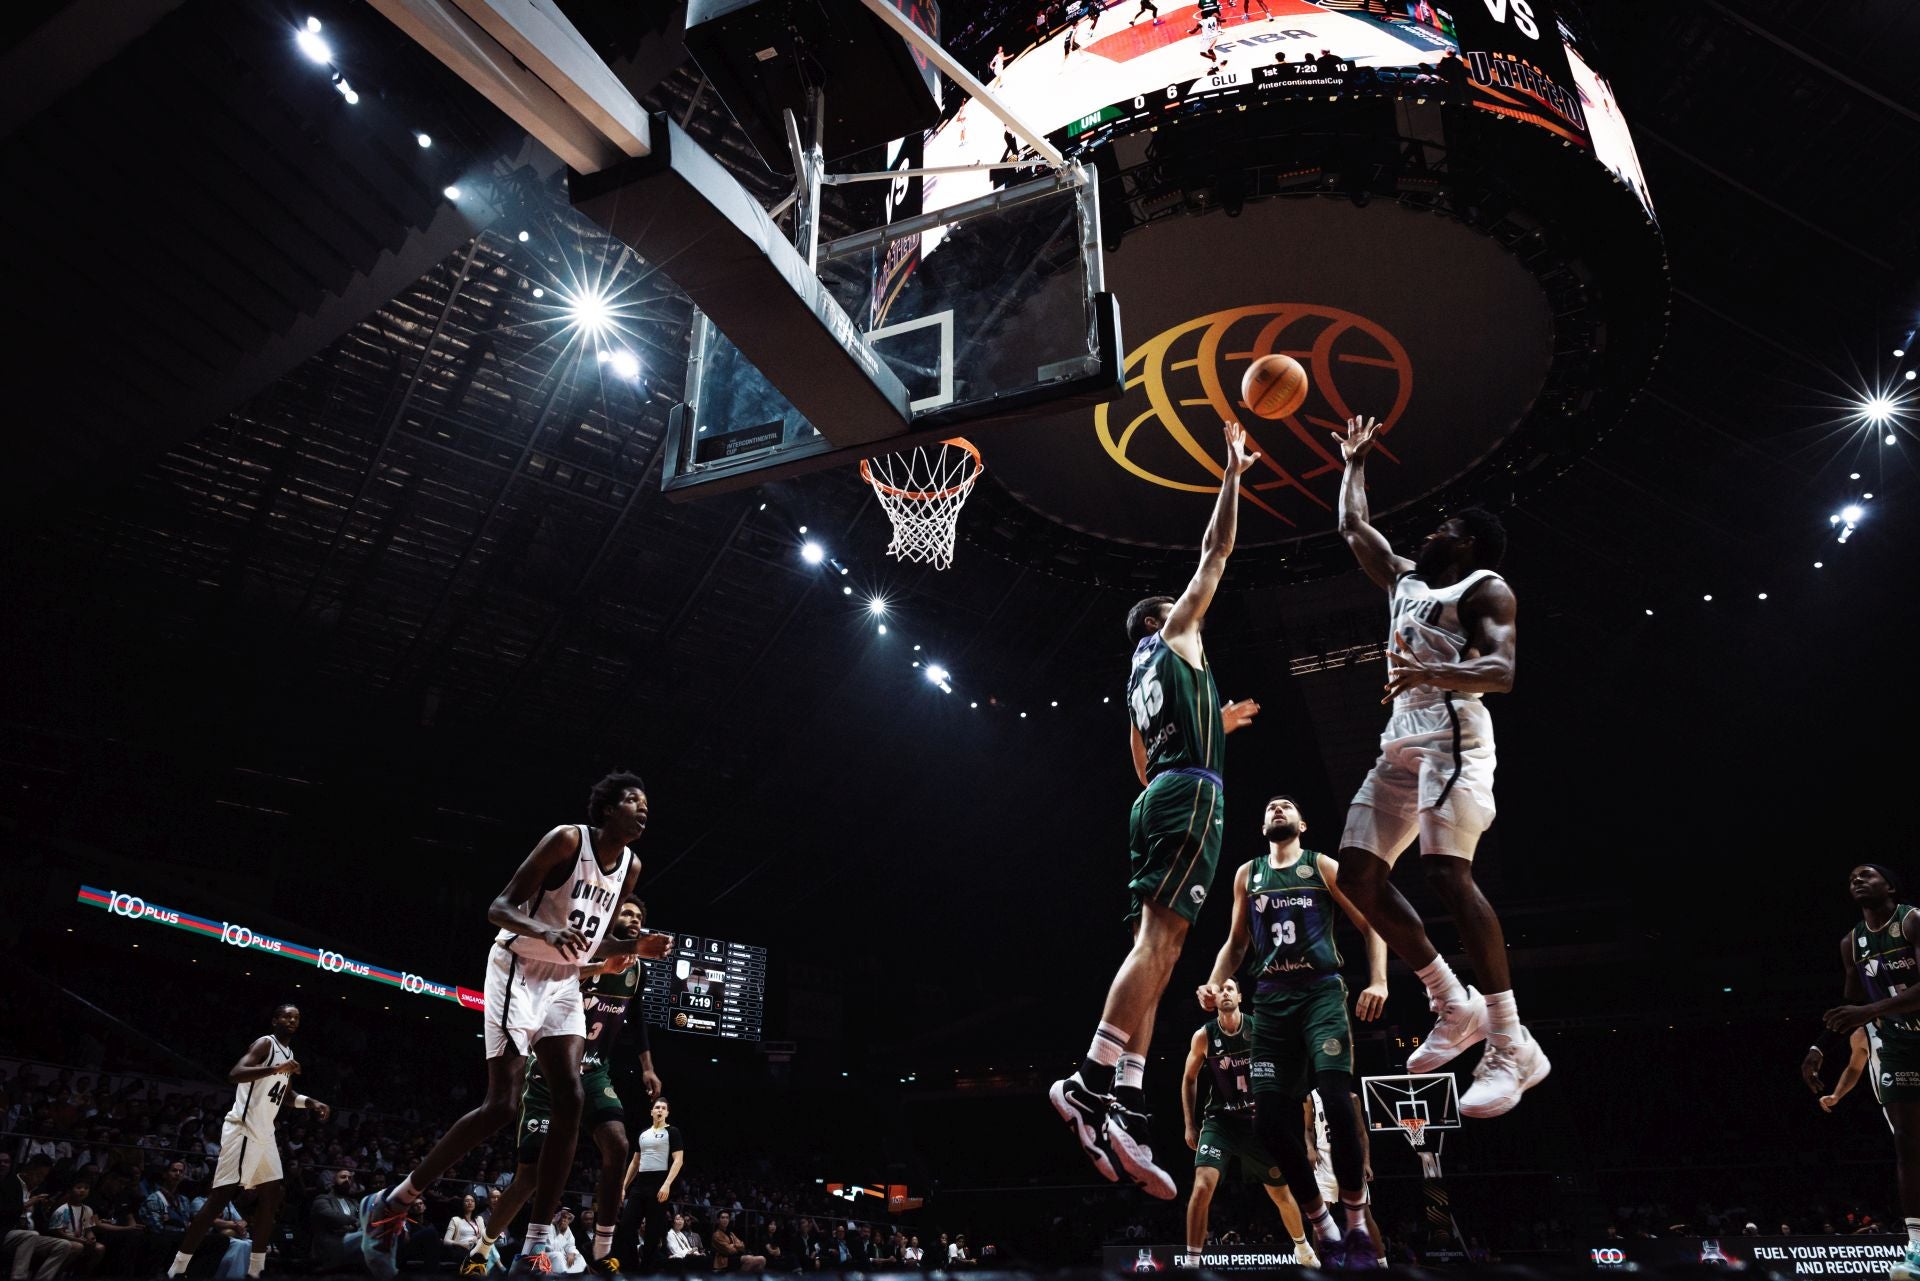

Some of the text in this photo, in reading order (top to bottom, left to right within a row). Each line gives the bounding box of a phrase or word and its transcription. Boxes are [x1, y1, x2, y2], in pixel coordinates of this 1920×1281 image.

[1484, 0, 1539, 40] VS
[1215, 29, 1318, 53] FIBA
[1263, 63, 1348, 77] 1st 7:20 10
[1258, 77, 1344, 91] #IntercontinentalCup
[1081, 73, 1237, 129] UNI 0 6 GLU
[1271, 896, 1313, 909] Unicaja
[1271, 920, 1296, 947] 33
[685, 938, 719, 953] 0 6
[689, 995, 711, 1008] 7:19
[587, 1021, 603, 1041] 3
[1591, 1248, 1624, 1264] 100
[1753, 1247, 1788, 1260] FUEL
[1788, 1246, 1827, 1260] YOUR
[1174, 1255, 1188, 1267] FU
[1201, 1254, 1229, 1266] YOUR
[1796, 1261, 1824, 1274] AND
